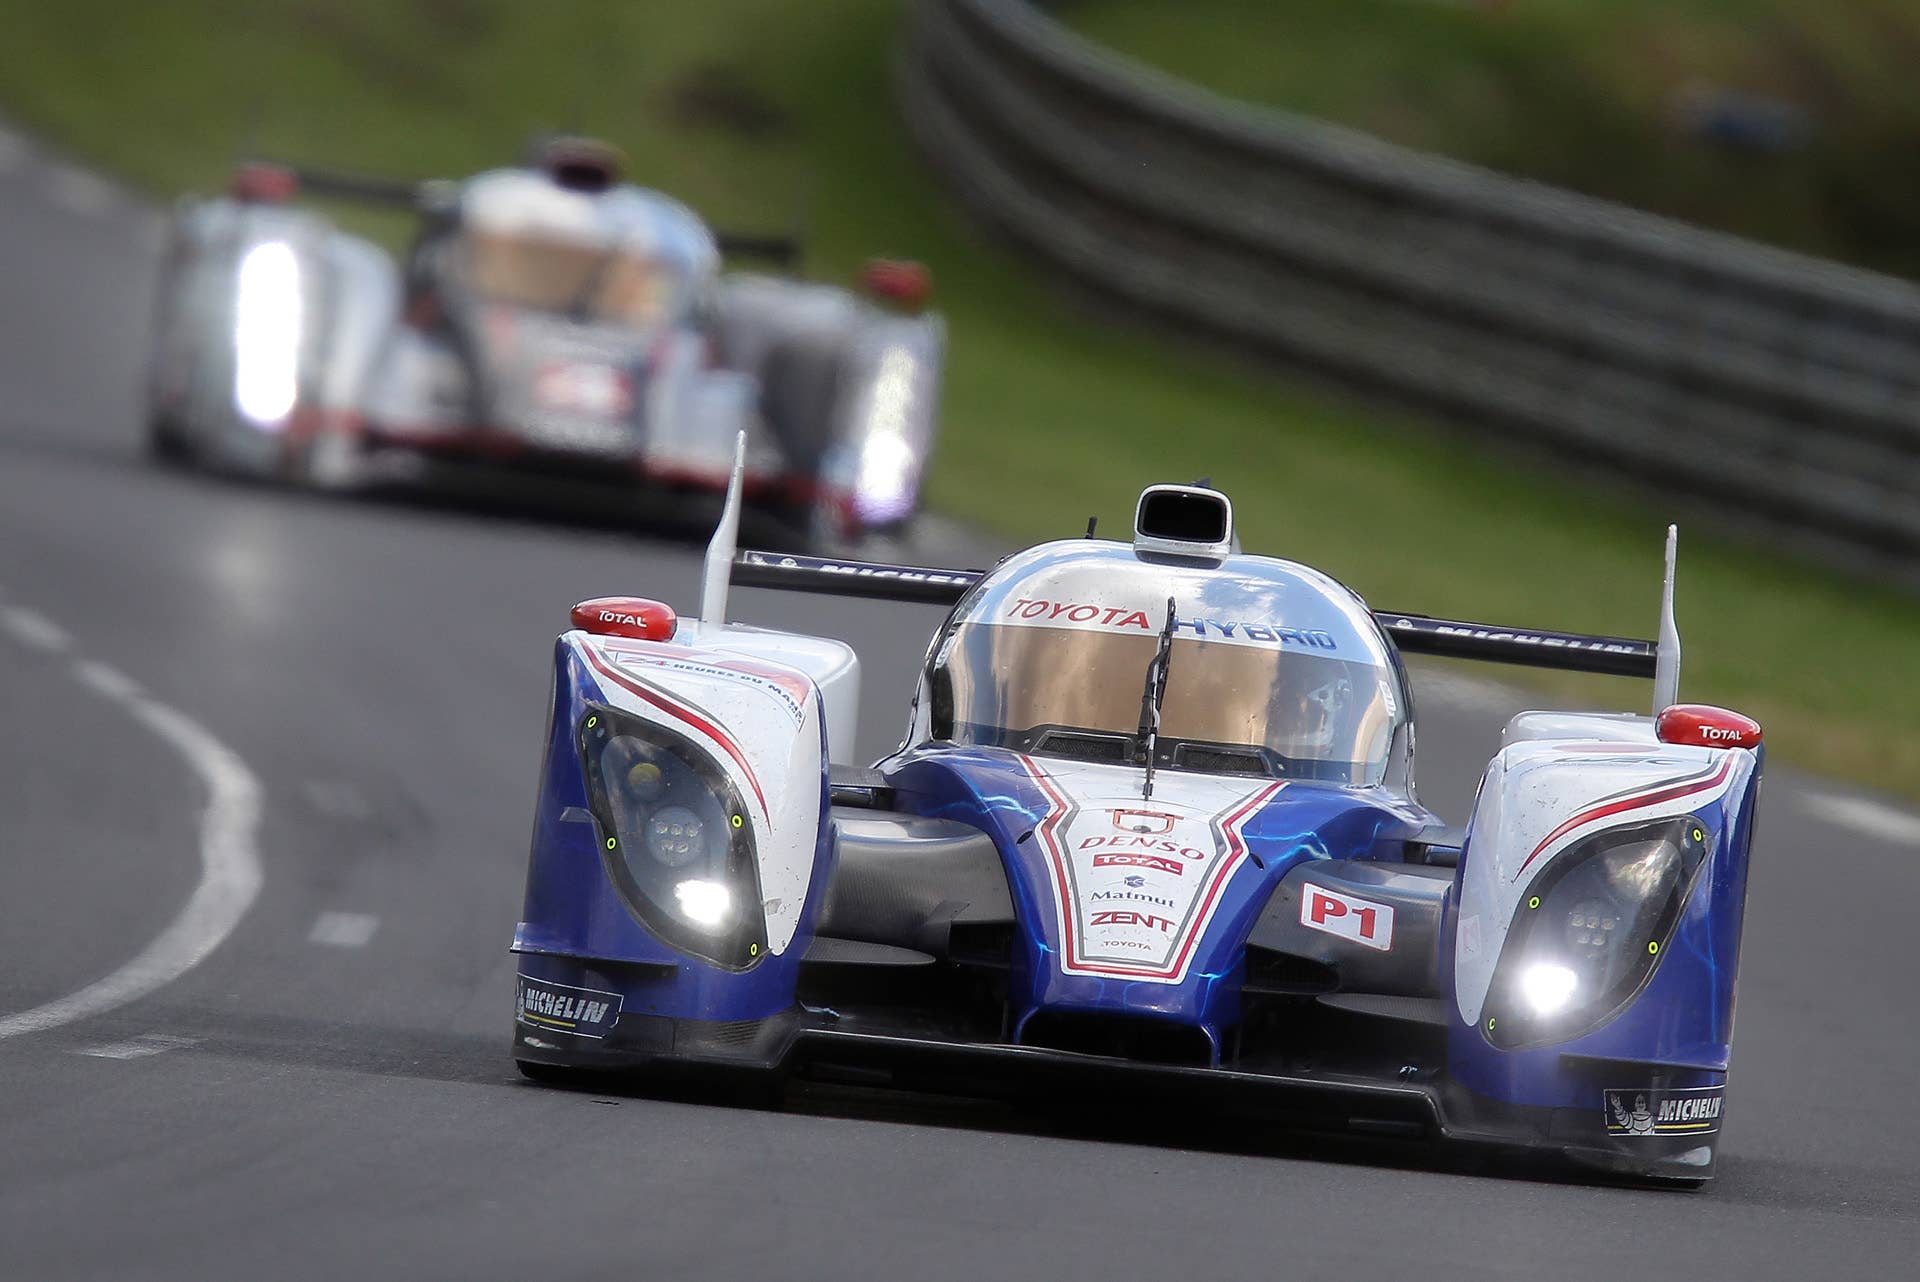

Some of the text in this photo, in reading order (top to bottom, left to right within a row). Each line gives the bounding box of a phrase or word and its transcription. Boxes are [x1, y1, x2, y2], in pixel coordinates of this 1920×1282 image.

[599, 610, 647, 628] TOTAL
[1007, 598, 1337, 651] TOYOTA HYBRID
[740, 675, 763, 684] DU
[1698, 725, 1743, 742] TOTAL
[1078, 835, 1205, 861] DENSO
[1096, 854, 1181, 873] TOTAL
[1090, 891, 1176, 908] Matmut
[1090, 911, 1176, 933] ZENT
[1310, 892, 1376, 940] P1
[1103, 940, 1152, 951] TOYOTA
[525, 987, 610, 1024] MICHELIN
[1657, 1096, 1722, 1121] MICHELIN
